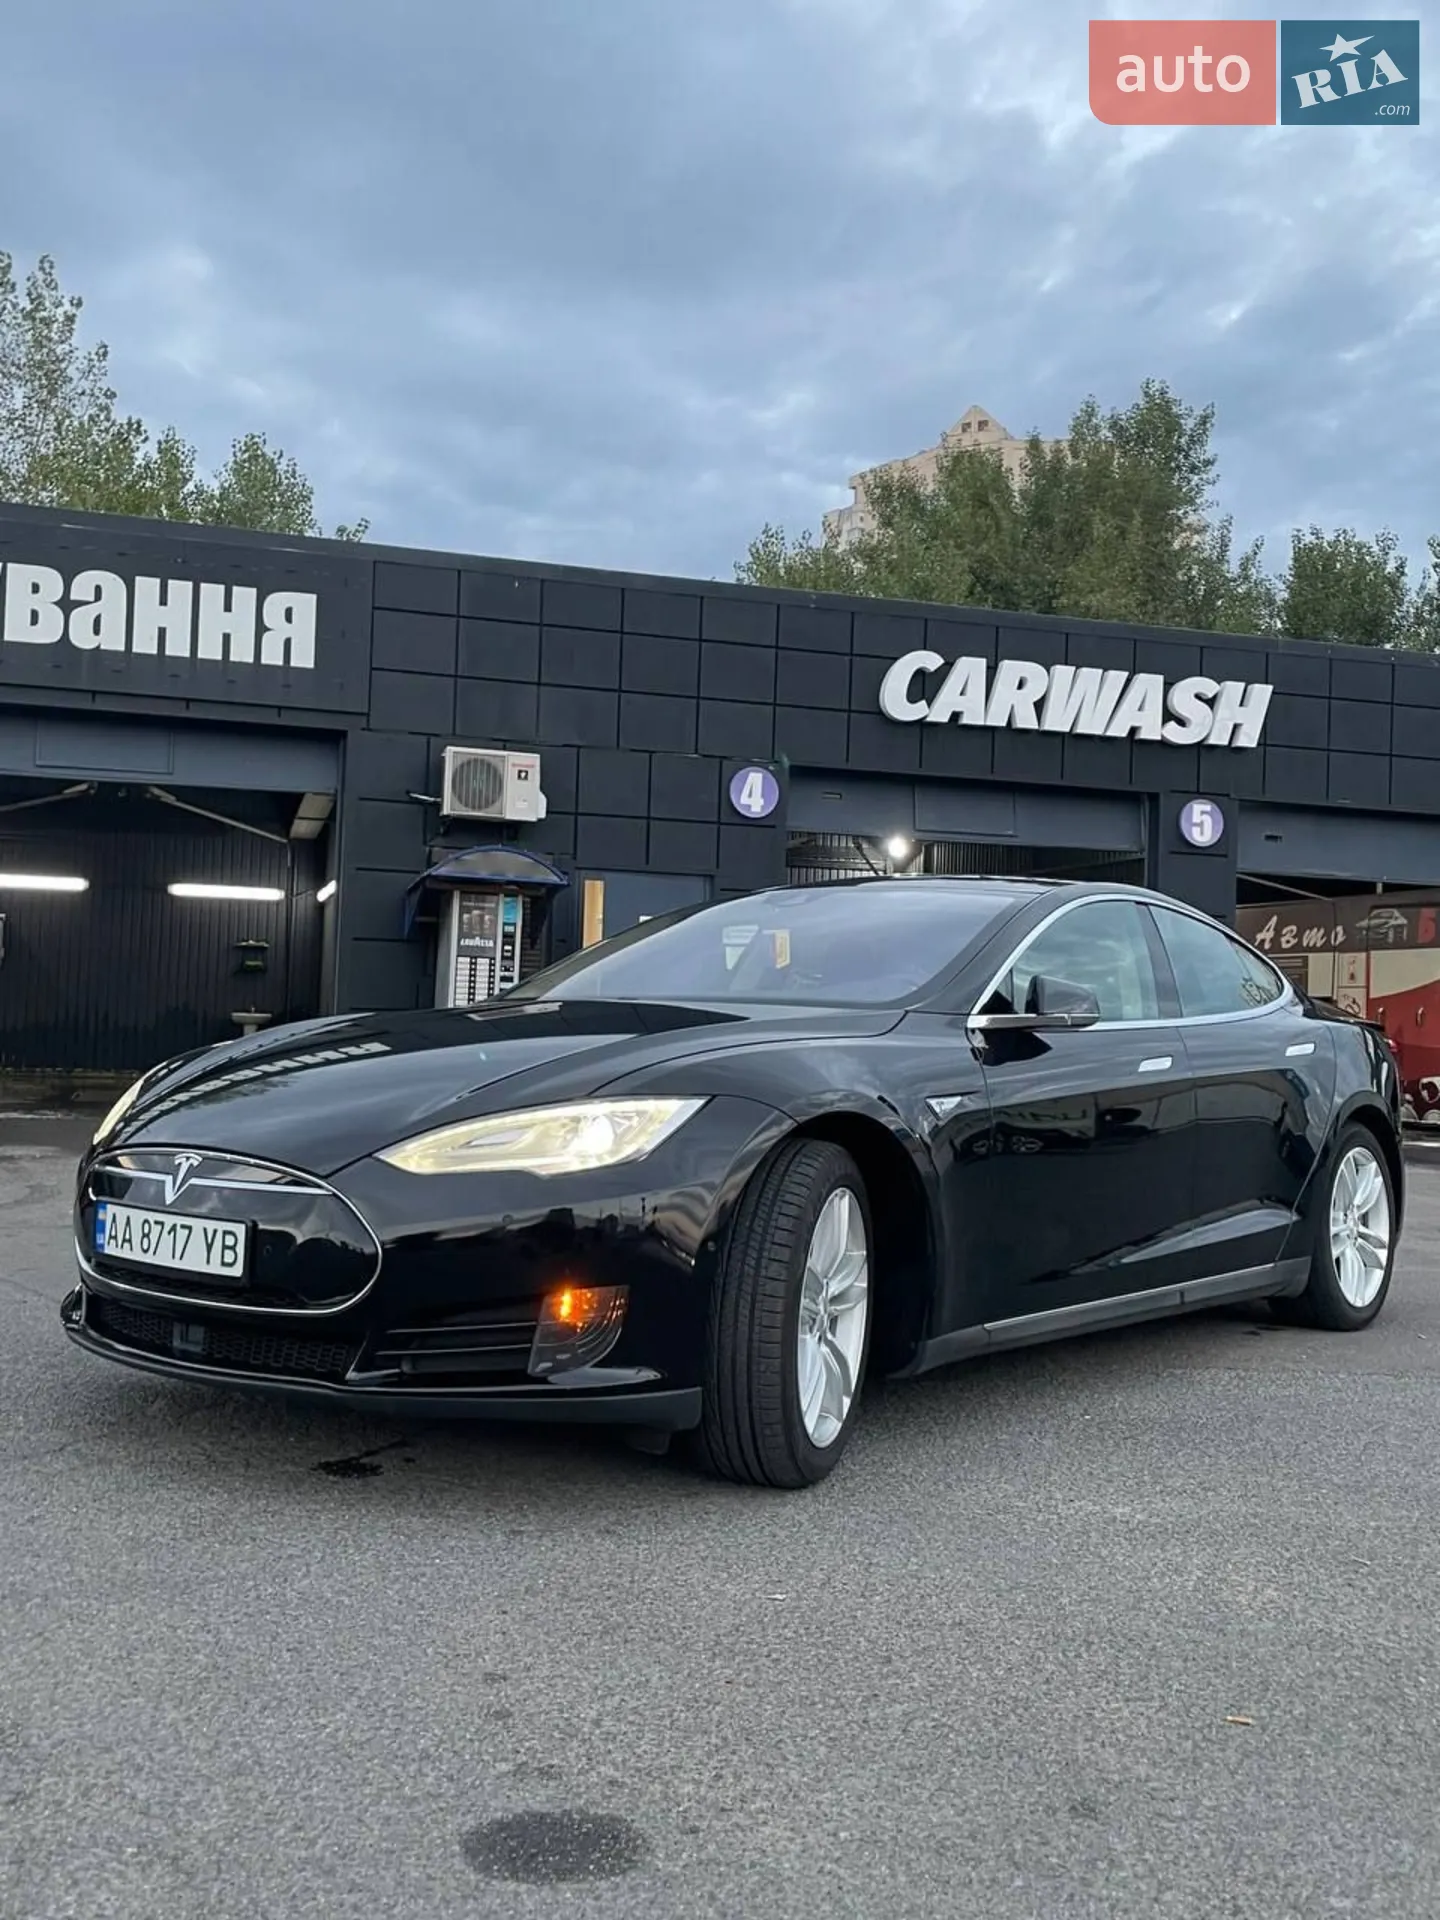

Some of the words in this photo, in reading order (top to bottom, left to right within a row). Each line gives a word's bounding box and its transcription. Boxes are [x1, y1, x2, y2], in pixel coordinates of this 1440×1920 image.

[0, 562, 317, 669] вання
[878, 650, 1273, 749] CARWASH
[740, 771, 764, 812] 4
[1191, 803, 1213, 842] 5
[107, 1212, 133, 1252] AA
[140, 1218, 193, 1262] 8717
[203, 1226, 239, 1268] YB
